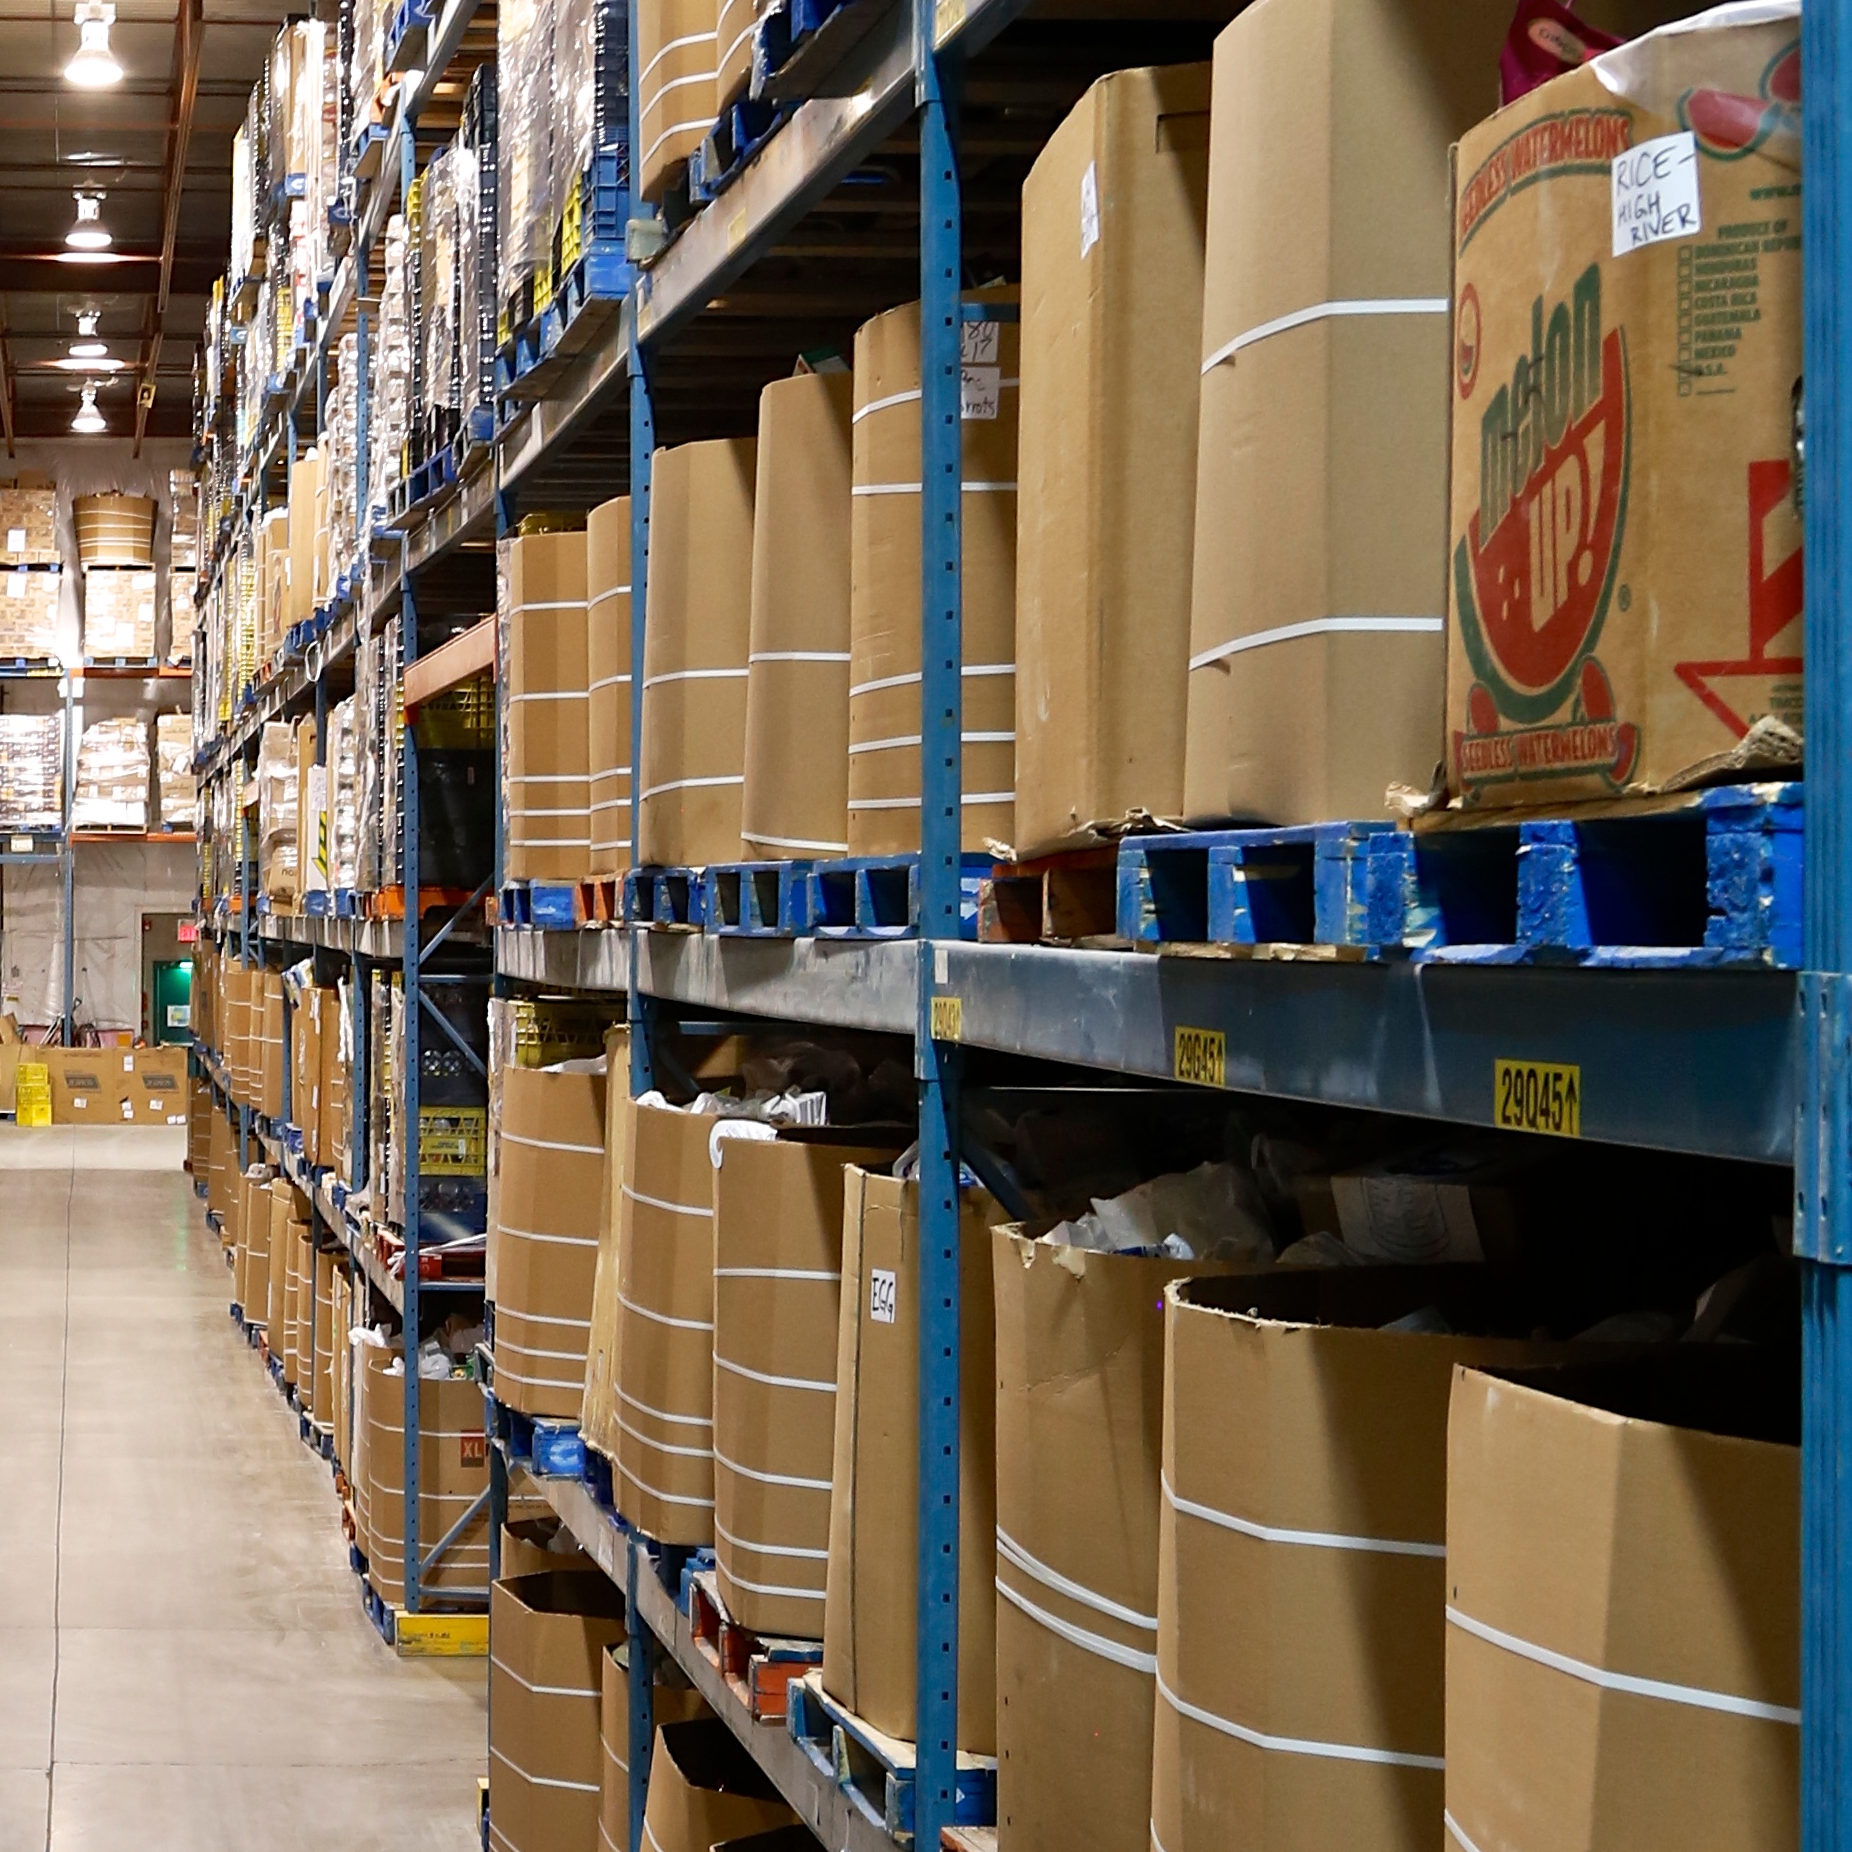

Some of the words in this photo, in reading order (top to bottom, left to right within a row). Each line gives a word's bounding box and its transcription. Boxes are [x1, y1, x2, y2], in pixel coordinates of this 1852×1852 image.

[1618, 191, 1661, 226] HIGH
[1631, 203, 1697, 246] RIVER
[1718, 221, 1770, 240] PRODUCT
[1773, 218, 1788, 235] OF
[1694, 240, 1760, 260] DOMINICAN
[1694, 257, 1758, 275] HONDURAS
[1694, 274, 1759, 292] NICARAGUA
[1694, 294, 1728, 310] COSTA
[1730, 291, 1758, 306] RICA
[1694, 308, 1762, 326] GUATEMALA
[1694, 327, 1743, 343] PANAMA
[1694, 344, 1737, 360] MEXICO
[1479, 262, 1602, 554] melon
[1528, 418, 1606, 634] UP!
[1517, 722, 1618, 766] WATERMELONS
